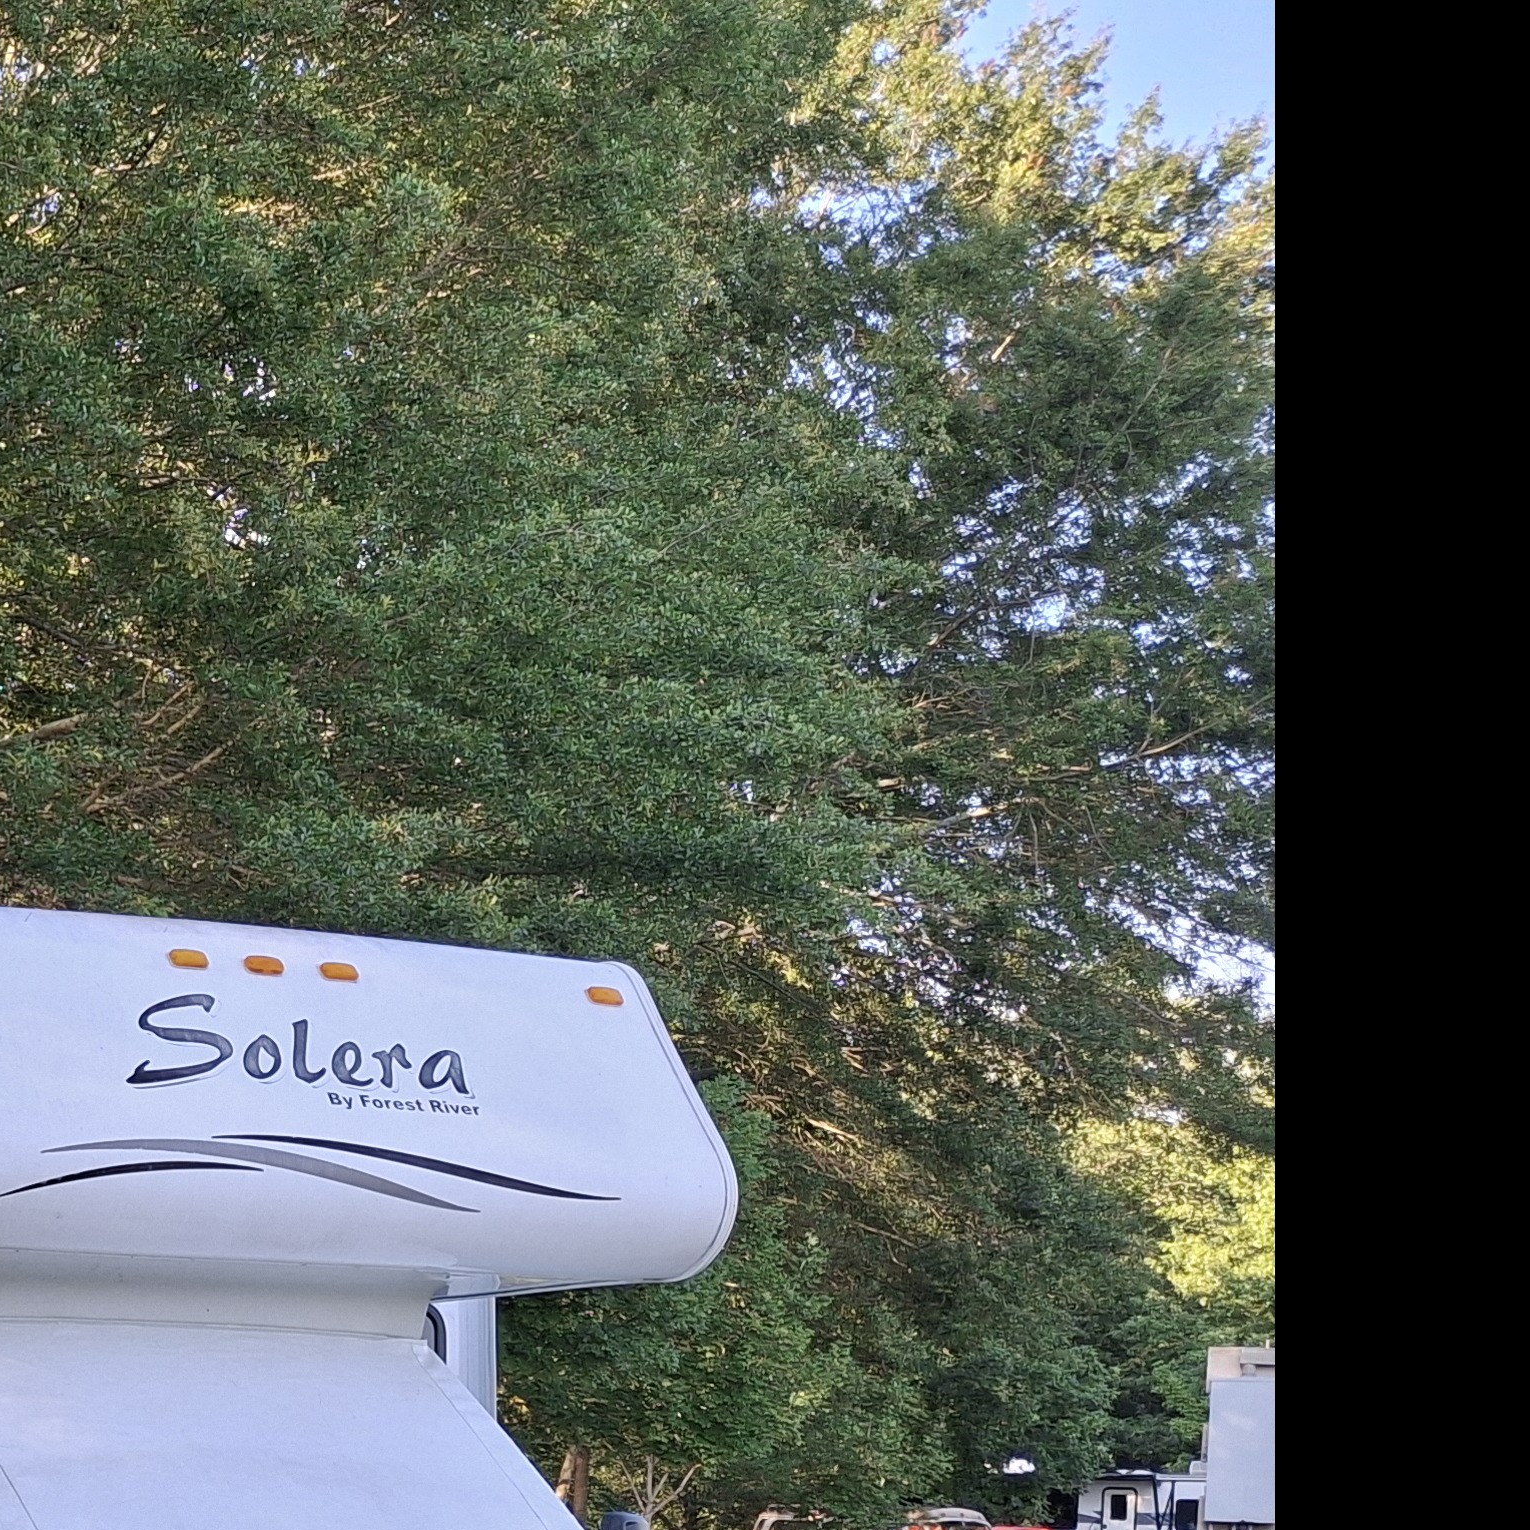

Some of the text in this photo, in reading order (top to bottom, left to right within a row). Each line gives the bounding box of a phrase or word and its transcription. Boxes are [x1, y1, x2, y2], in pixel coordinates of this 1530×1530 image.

[126, 993, 473, 1096] Solera
[327, 1092, 480, 1116] By Forest River
